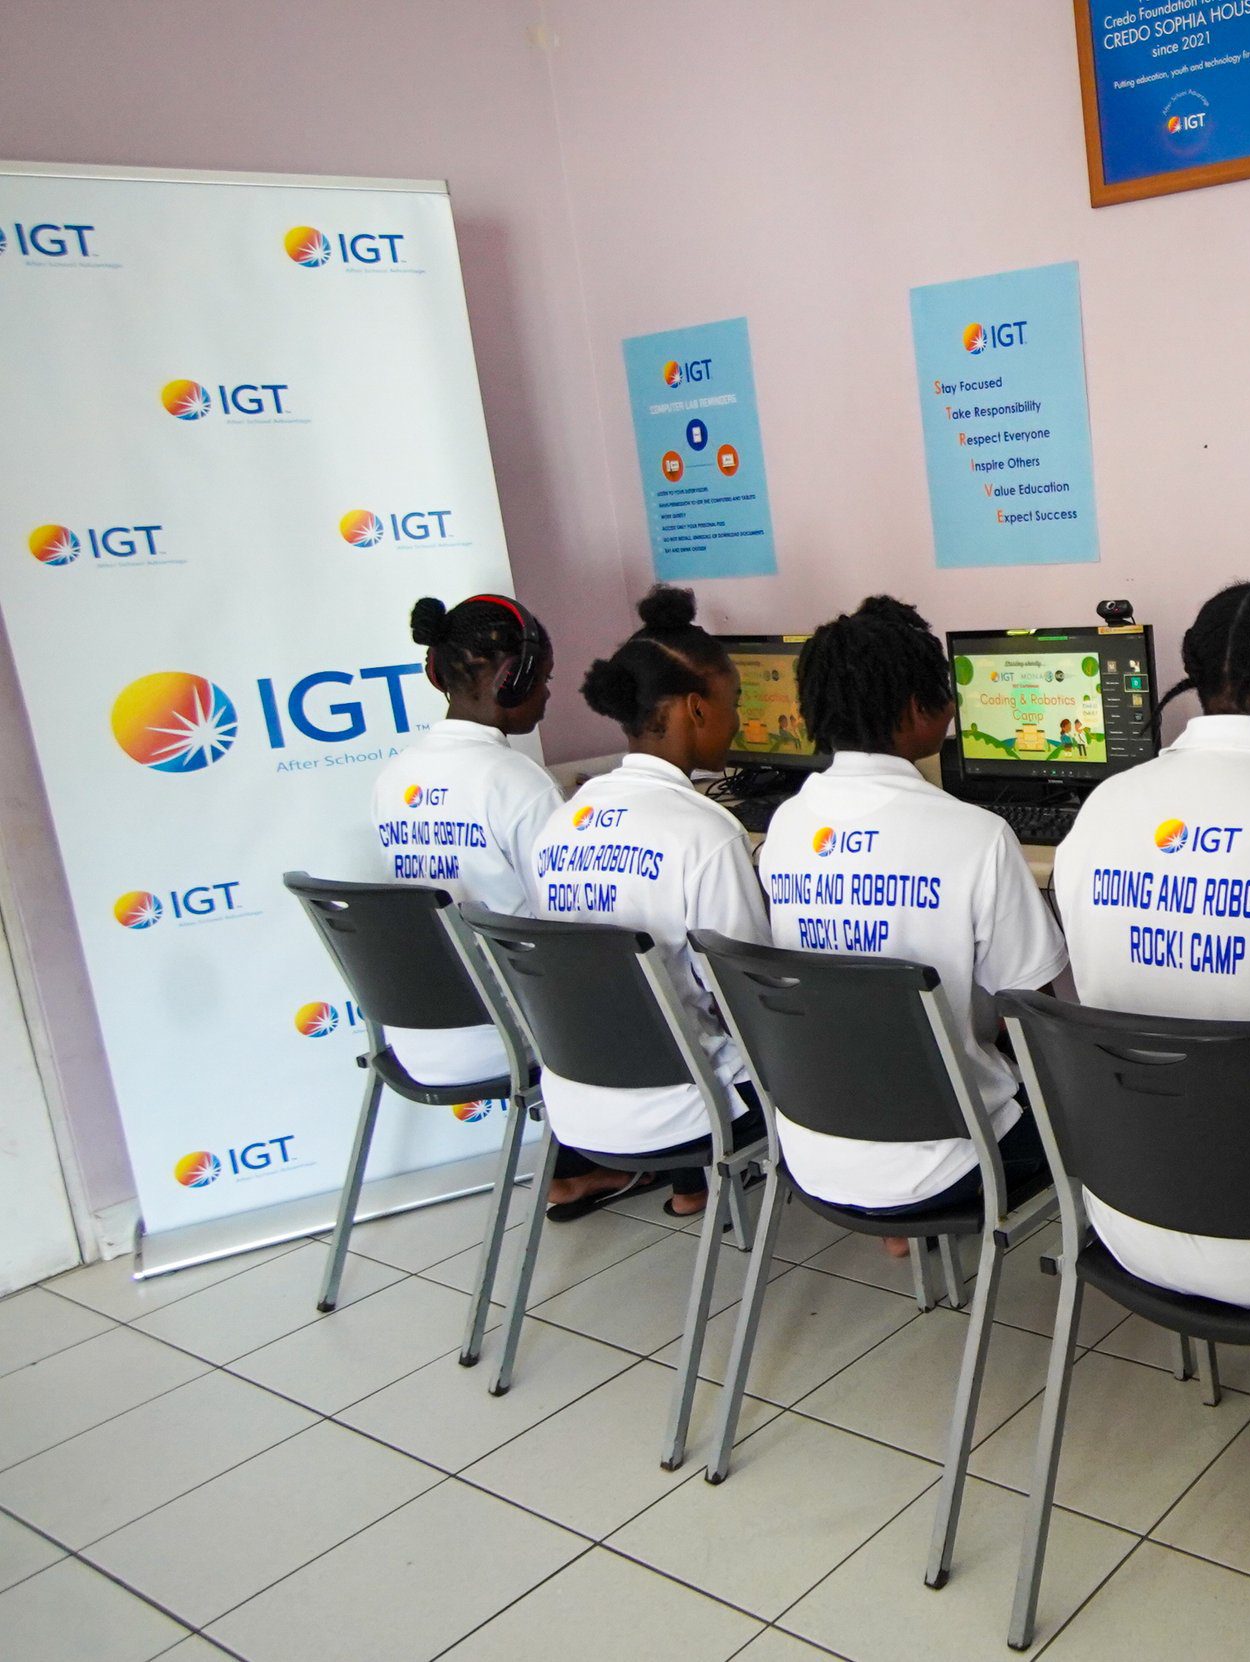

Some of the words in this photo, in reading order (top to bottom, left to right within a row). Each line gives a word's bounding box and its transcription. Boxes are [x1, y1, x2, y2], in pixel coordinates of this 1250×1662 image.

[1104, 11, 1136, 29] Credo
[1139, 0, 1197, 20] Foundation
[1104, 25, 1150, 50] CREDO
[1155, 10, 1207, 37] SOPHIA
[1152, 44, 1178, 57] since
[1182, 31, 1210, 50] 2021
[1113, 78, 1135, 89] Putting
[1171, 65, 1189, 78] youth
[1190, 61, 1203, 72] and
[1205, 54, 1241, 68] technology
[1184, 113, 1206, 130] IGT
[14, 223, 95, 257] IGT
[339, 233, 404, 264] IGT
[991, 321, 1027, 349] IGT
[685, 358, 712, 382] IGT
[218, 384, 288, 415] IGT
[934, 380, 957, 395] Stay
[960, 377, 1003, 392] Focused
[946, 406, 971, 421] Take
[974, 400, 1041, 418] Responsibility
[959, 432, 1001, 447] Respect
[1004, 429, 1050, 444] Everyone
[970, 459, 1004, 473] Inspire
[1007, 457, 1040, 469] Others
[984, 484, 1016, 497] Value
[1019, 482, 1070, 495] Education
[390, 510, 452, 541] IGT
[997, 509, 1032, 525] Expect
[1035, 510, 1078, 522] Success
[88, 525, 163, 558] IGT
[1000, 672, 1015, 682] IGT
[257, 662, 423, 749] IGT
[980, 693, 1016, 708] Coding
[1020, 694, 1027, 705] &
[1030, 693, 1076, 706] Robotics
[1012, 709, 1044, 723] Camp
[276, 759, 319, 773] After
[324, 749, 383, 767] School
[426, 788, 449, 806] IGT
[595, 808, 628, 828] IGT
[412, 821, 430, 845] AND
[840, 830, 879, 853] IGT
[1191, 826, 1243, 853] IGT
[395, 854, 427, 879] ROCK!
[567, 846, 596, 872] AND
[593, 844, 664, 880] ROBOTICS
[170, 881, 240, 919] IGT
[548, 883, 581, 912] ROCK!
[771, 873, 812, 905] CODING
[815, 873, 844, 905] AND
[851, 874, 941, 909] ROBOTICS
[1093, 868, 1154, 909] CODING
[1156, 874, 1198, 914] AND
[798, 918, 837, 950] ROCK!
[843, 919, 889, 952] CAMP
[1130, 925, 1184, 969] ROCK!
[1190, 932, 1246, 975] CAMP
[229, 1134, 295, 1175] IGT
